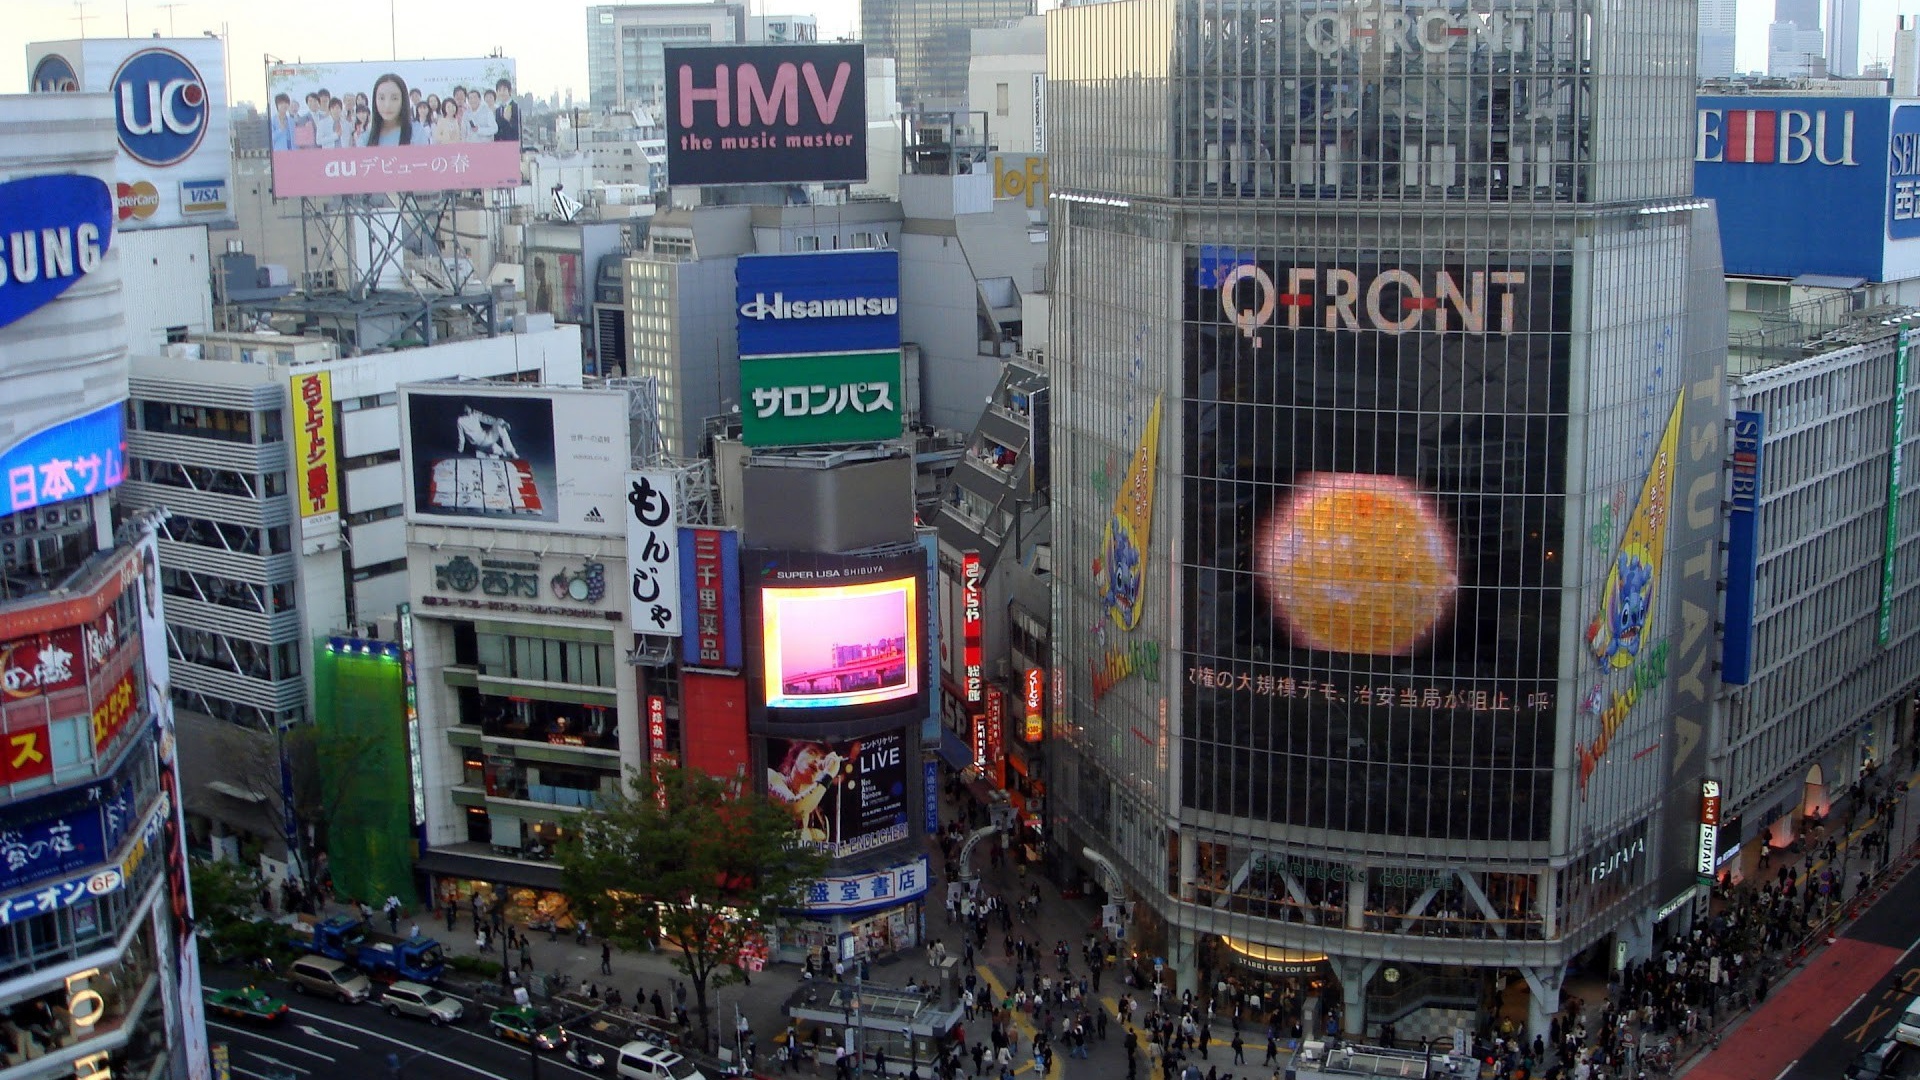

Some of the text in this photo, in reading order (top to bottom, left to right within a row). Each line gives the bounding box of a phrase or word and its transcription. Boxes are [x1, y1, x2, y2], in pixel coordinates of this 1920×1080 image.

[679, 61, 852, 129] HMV
[681, 131, 853, 151] the music master
[325, 152, 470, 178] au デビューの春
[191, 189, 220, 202] VISA
[741, 291, 898, 320] Hisamitsu
[1221, 263, 1526, 348] QFRONT
[752, 381, 894, 419] サロンパス
[1732, 419, 1759, 513] SEIBU
[628, 476, 672, 629] もんじゃ
[481, 569, 540, 599] 西村
[777, 565, 884, 579] SUPER LISA SHIBUYA
[697, 537, 720, 660] 三千里薬品
[1189, 667, 1555, 713] 権の大規模デモ、治安当局が阻止。呼
[10, 732, 44, 769] ス
[860, 747, 900, 774] LIVE
[1702, 824, 1713, 875] TSUTAYA
[92, 872, 115, 893] 6F
[789, 869, 916, 904] 盛堂書店
[1255, 858, 1454, 891] STARBUCKS COFFEE
[1239, 957, 1317, 974] STARBUCKS COFFEE
